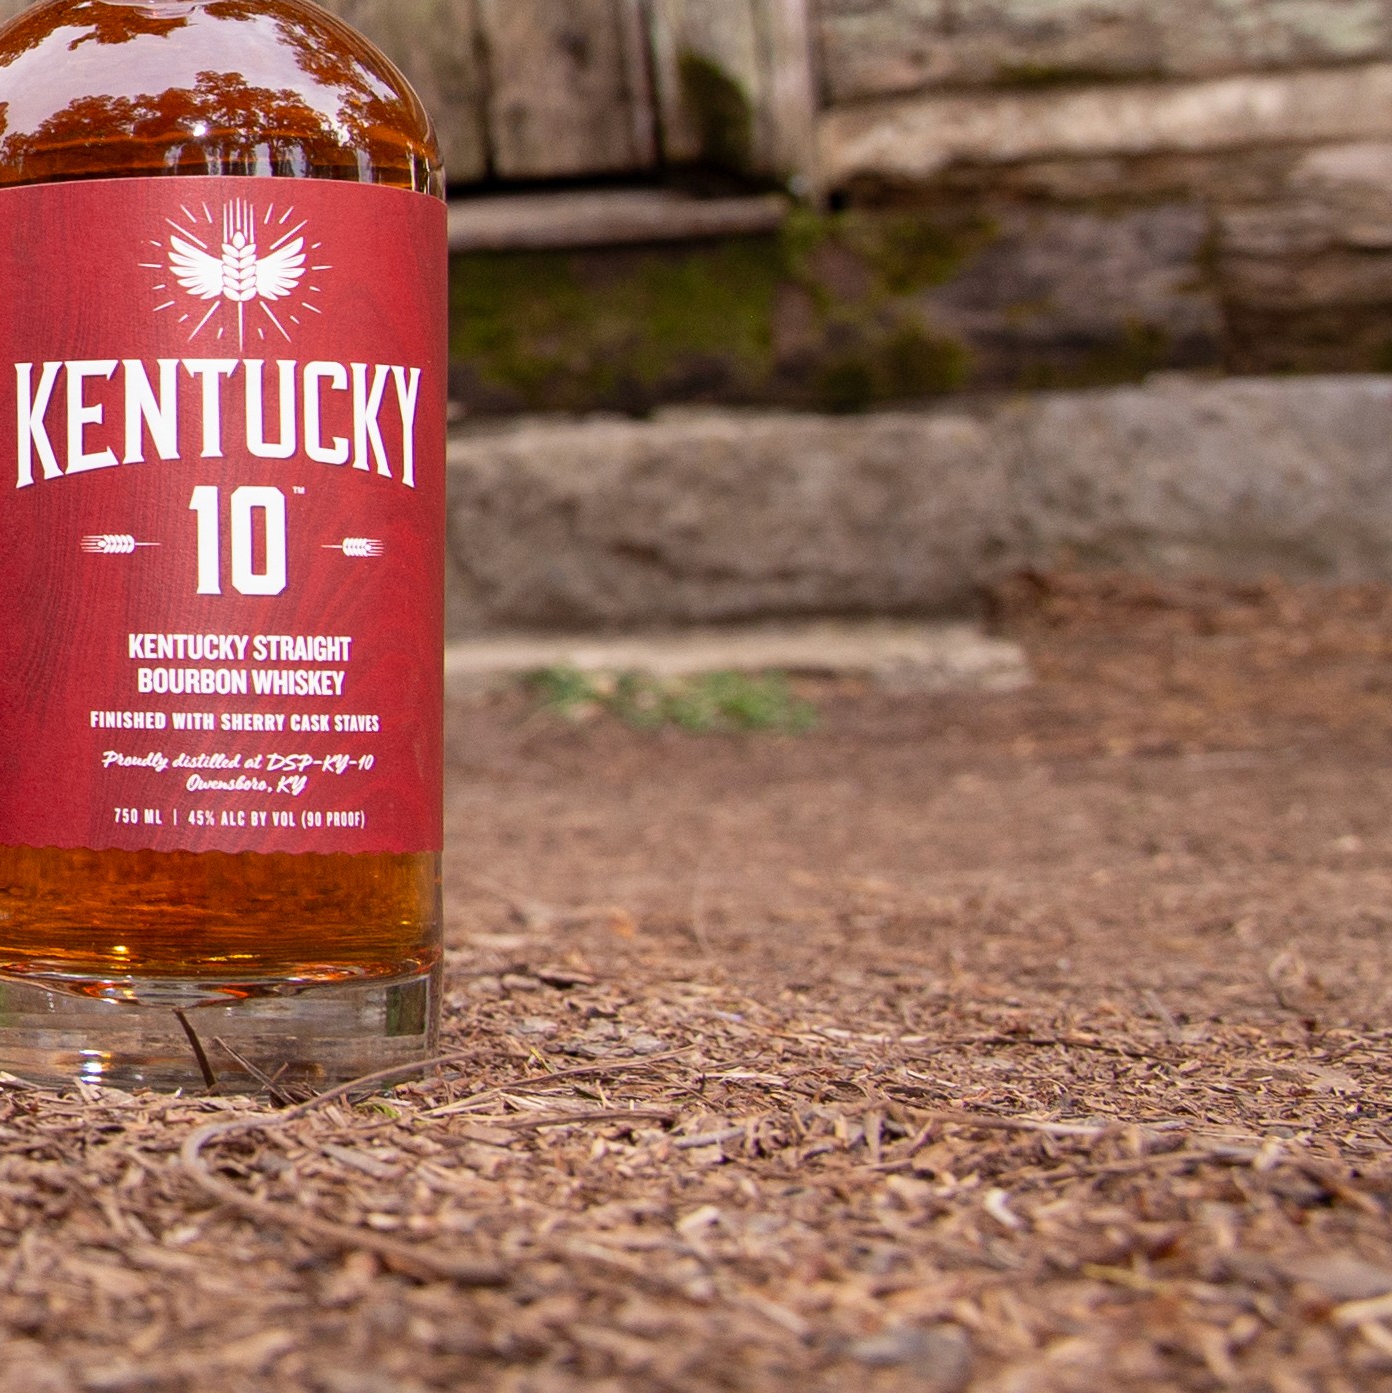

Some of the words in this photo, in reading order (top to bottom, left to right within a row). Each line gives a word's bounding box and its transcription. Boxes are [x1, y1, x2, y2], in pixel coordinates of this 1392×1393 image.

[15, 358, 421, 489] KENTUCKY
[188, 485, 287, 596] 10
[128, 633, 249, 660] KENTUCKY
[252, 635, 352, 662] STRAIGHT
[137, 667, 248, 695] BOURBON
[251, 670, 346, 696] WHISKEY
[90, 711, 166, 730] FINISHED
[172, 712, 215, 730] WITH
[220, 713, 285, 731] SHERRY
[290, 714, 330, 732] CASK
[334, 714, 380, 733] STAVES
[102, 750, 169, 772] Proudly
[172, 753, 241, 770] distilled
[243, 755, 263, 770] at
[266, 754, 375, 774] DSP-KY-10
[185, 774, 274, 794] Owensboro,
[276, 775, 308, 796] KY
[114, 808, 138, 824] 750
[144, 809, 163, 825] ML
[188, 810, 215, 826] 45%
[220, 811, 246, 827] ALC
[250, 811, 267, 827] BY
[272, 811, 296, 827] VOL
[301, 811, 322, 829] (90
[326, 811, 366, 829] PROOF)
